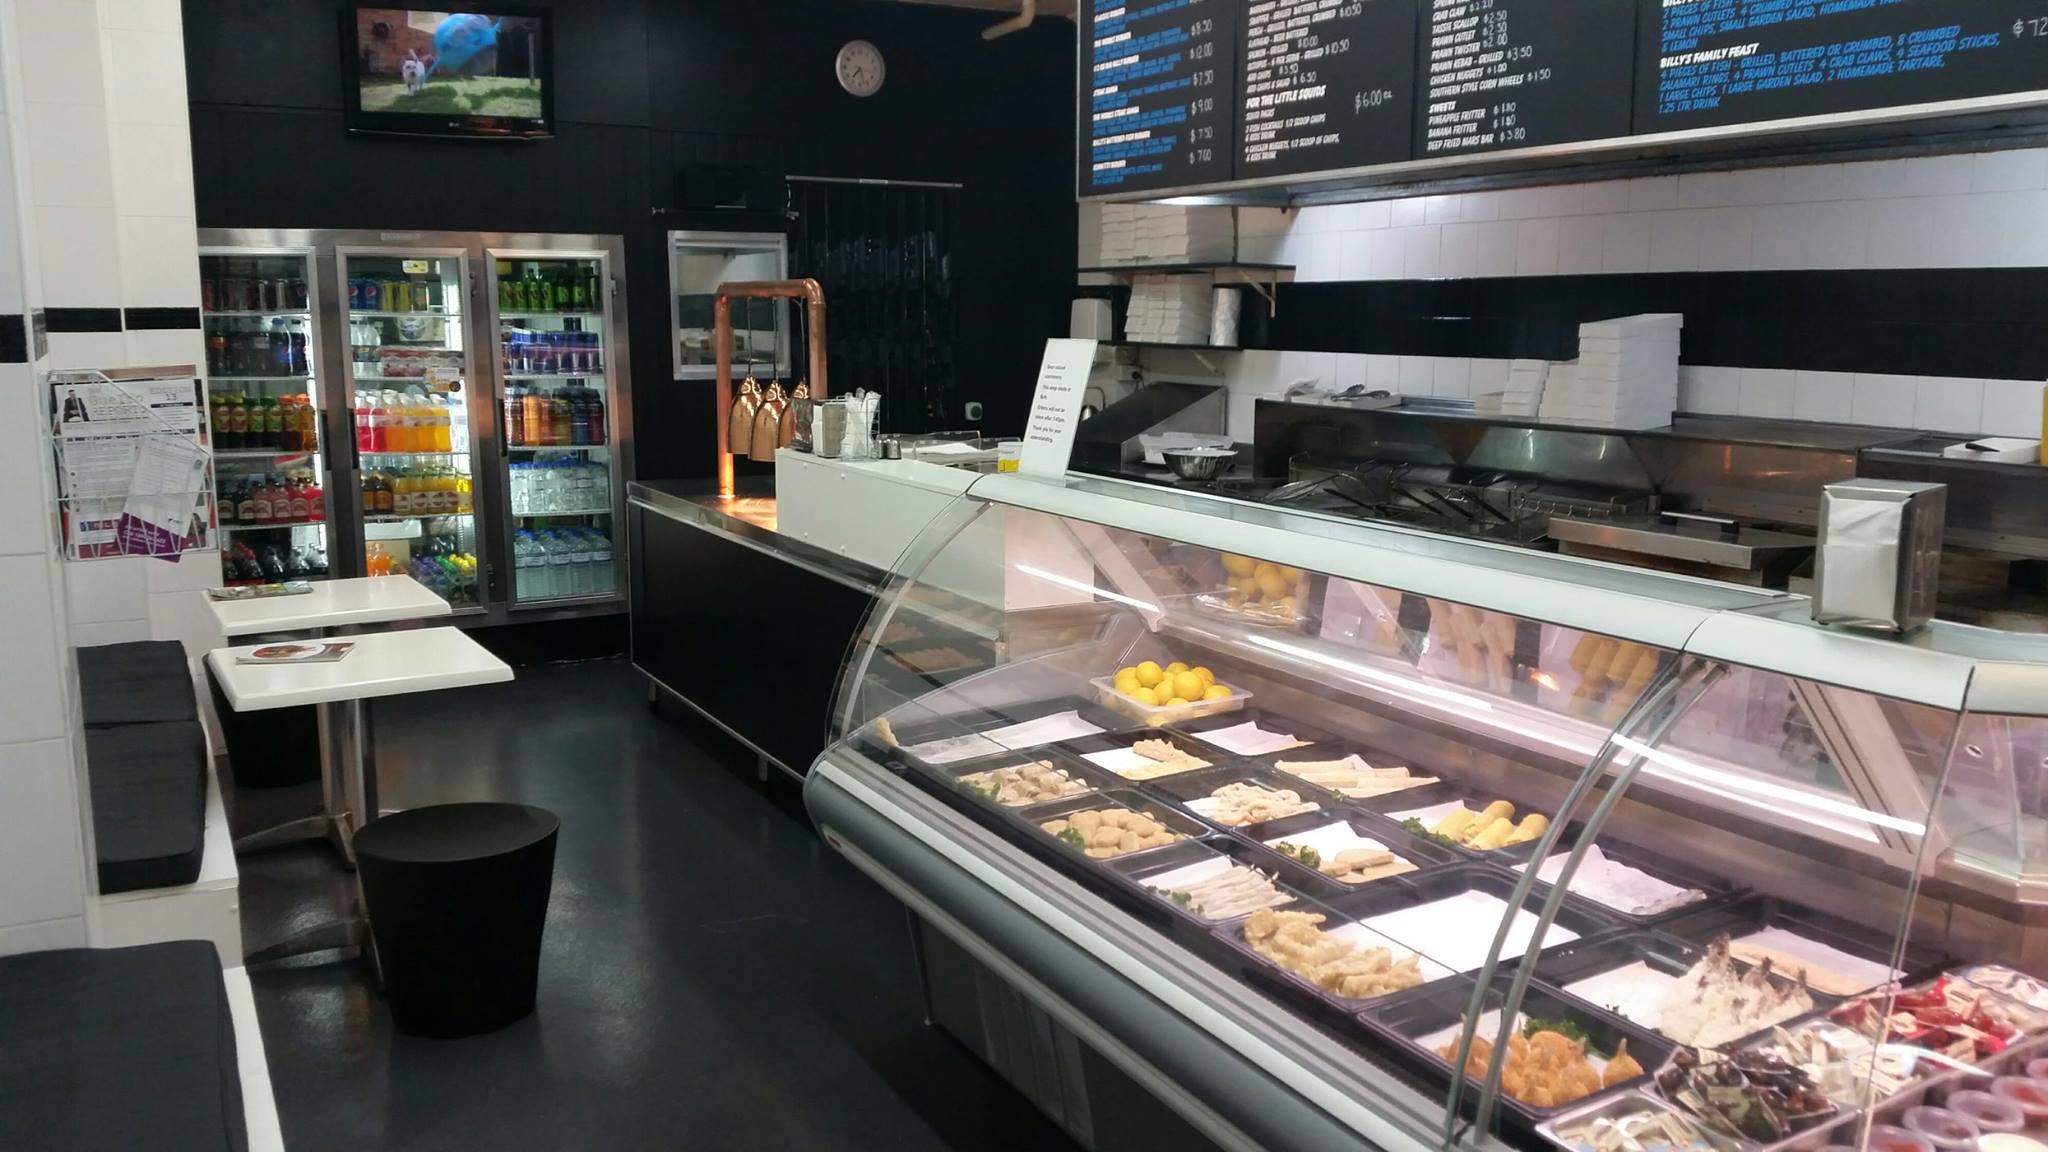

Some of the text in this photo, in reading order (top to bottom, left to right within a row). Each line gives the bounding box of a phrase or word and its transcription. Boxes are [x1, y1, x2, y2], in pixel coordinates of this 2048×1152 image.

[1449, 6, 1466, 18] CLAW
[1664, 8, 1669, 18] 2
[1670, 3, 1698, 17] PIECES
[1700, 0, 1710, 11] OF
[1453, 16, 1479, 30] SCALLOP
[1662, 30, 1687, 41] SMALL
[1689, 23, 1717, 36] CHIPS,
[1719, 19, 1745, 32] SMALL
[1748, 11, 1784, 27] GARDEN
[1786, 7, 1816, 21] SALAD,
[1663, 19, 1669, 30] 2
[1671, 14, 1701, 28] PRAWN
[1432, 35, 1454, 47] PRAWN
[1455, 30, 1475, 42] CUTLET
[1670, 38, 1698, 51] LEMON
[1431, 47, 1454, 60] PRAWN
[1454, 42, 1480, 55] TWISTER
[1660, 43, 1759, 68] BILLY'S FAMILY FEAST
[1661, 70, 1666, 79] 4
[1670, 65, 1696, 78] PIECES
[1699, 64, 1708, 73] OF
[1712, 60, 1732, 71] FISH
[1780, 46, 1825, 62] BATTERED
[1827, 44, 1841, 55] OR
[1897, 33, 1906, 45] 8
[1908, 25, 1960, 44] CRUMBED
[1431, 60, 1453, 72] PRAWN
[1453, 57, 1473, 68] KEBAB
[1479, 51, 1503, 64] GRILLED
[1660, 76, 1700, 91] CALAMARI
[1734, 71, 1740, 80] 4
[1743, 66, 1776, 80] PRAWN
[1819, 59, 1826, 69] 4
[1830, 55, 1854, 68] CRAB
[1896, 48, 1904, 58] 4
[1908, 39, 1956, 57] SEAFOOD
[1430, 73, 1456, 85] CHICKEN
[1456, 68, 1484, 80] NUGGETS
[1665, 90, 1689, 101] LARGE
[1728, 81, 1754, 94] LARGE
[1756, 75, 1793, 91] GARDEN
[1828, 70, 1835, 81] 2
[1837, 60, 1894, 80] HOMEMADE
[1430, 84, 1461, 98] SOUTHERN
[1461, 83, 1478, 93] STYLE
[1480, 79, 1497, 90] CORN
[1498, 75, 1523, 87] WHEELS
[1246, 85, 1326, 108] FOR THE LITTLE SQUIDS
[1355, 90, 1382, 114] $6.00
[1429, 101, 1456, 113] SWEETS
[1659, 97, 1722, 114] 1.25 LTR DRINK
[1428, 112, 1459, 125] PINEAPPLE
[1461, 108, 1486, 121] FRITTER
[1428, 127, 1452, 138] BANANA
[1453, 123, 1477, 134] FRITTER
[1427, 140, 1442, 151] DEEP
[1443, 138, 1461, 149] FRIED
[1462, 135, 1480, 146] MARS
[1481, 134, 1494, 143] BAR
